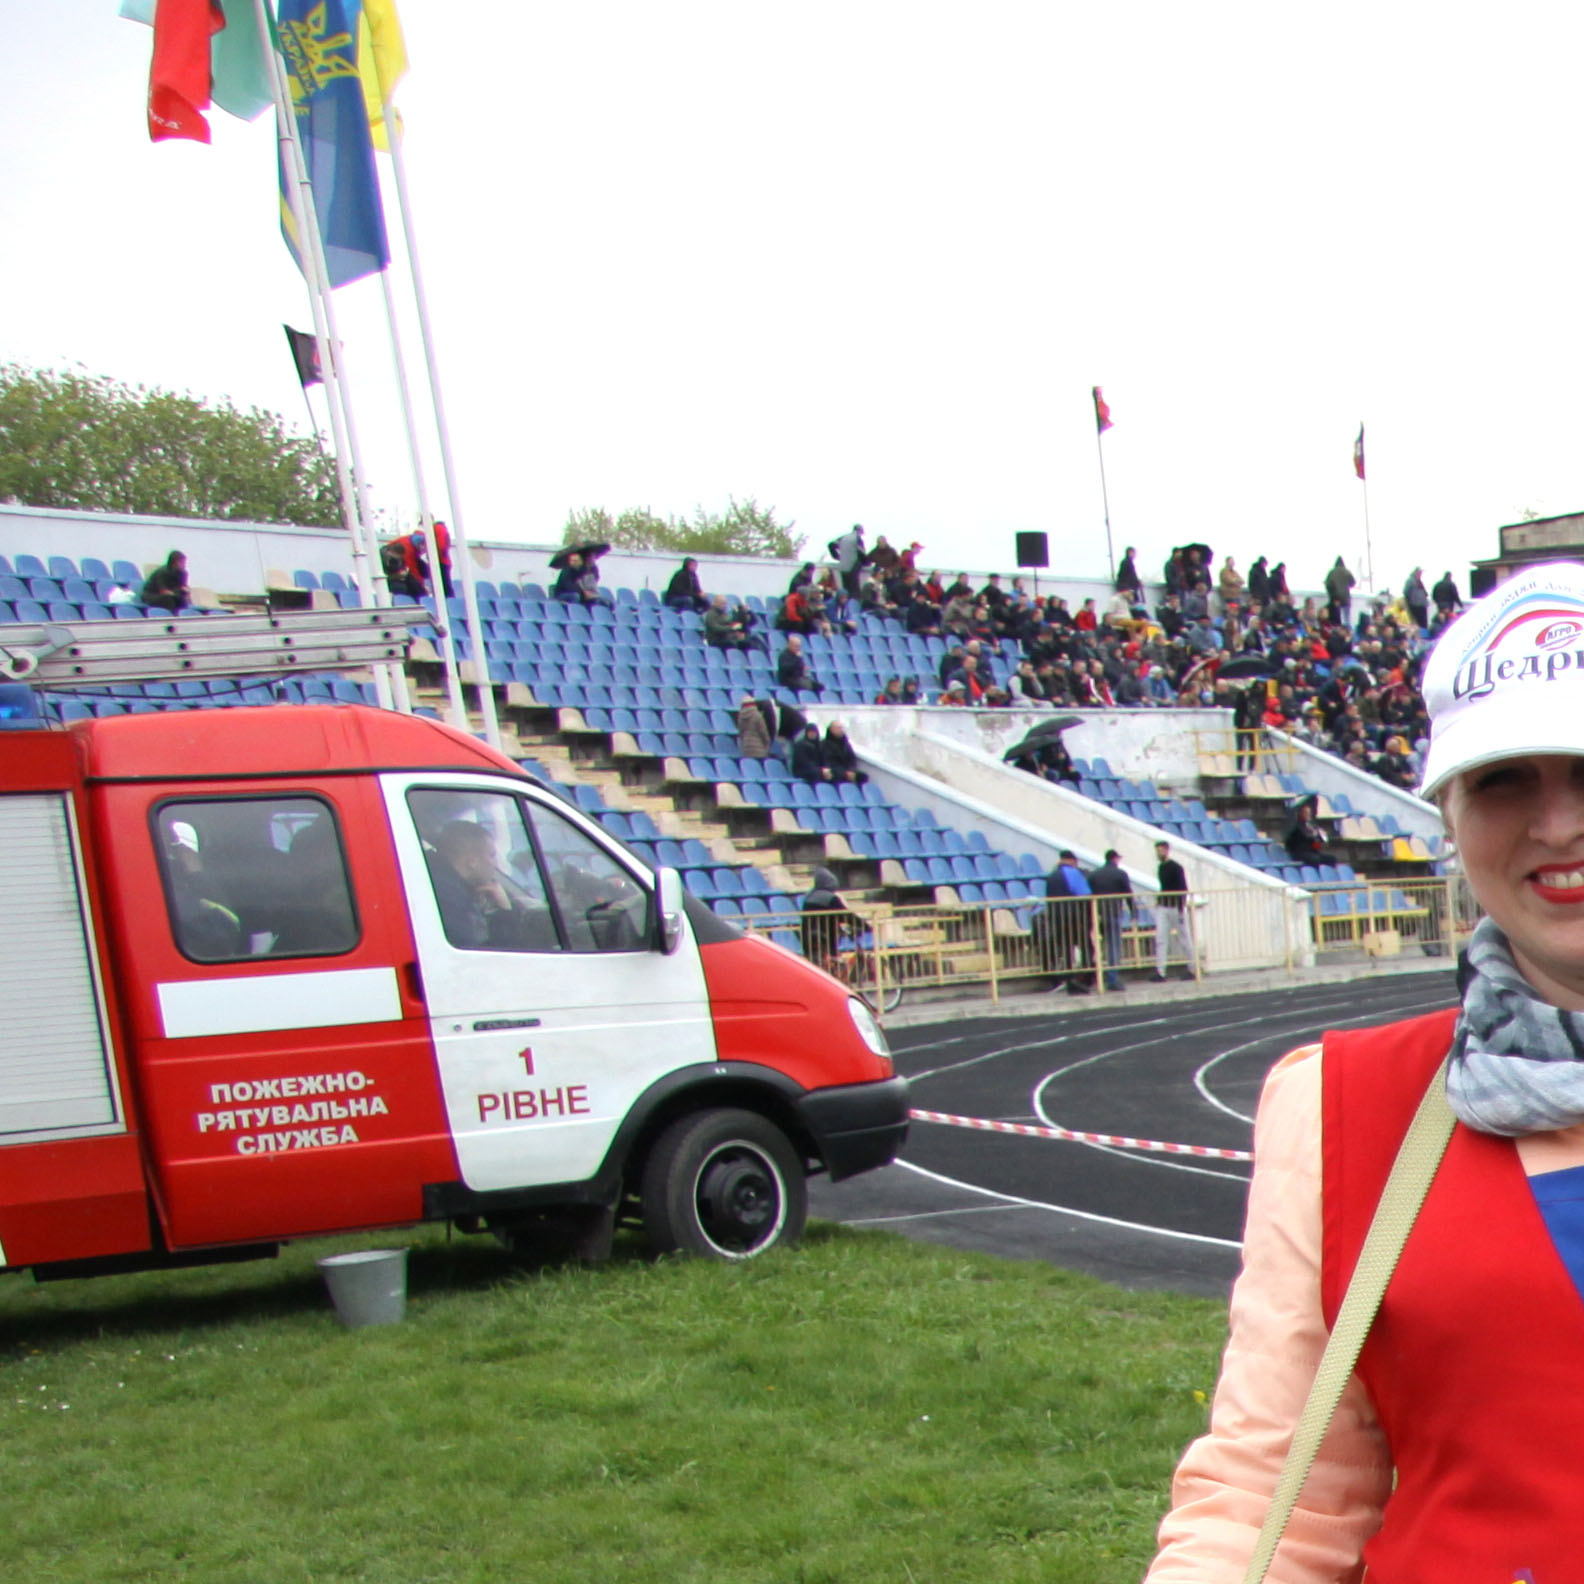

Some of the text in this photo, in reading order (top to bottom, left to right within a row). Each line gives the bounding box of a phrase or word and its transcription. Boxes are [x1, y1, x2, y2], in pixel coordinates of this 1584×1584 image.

[518, 1046, 535, 1076] 1
[210, 1071, 375, 1104] ПОЖЕЖНО-
[477, 1085, 591, 1123] РІВНЕ
[198, 1096, 389, 1133] РЯТУВАЛЬНА
[236, 1124, 360, 1155] СЛУЖБА
